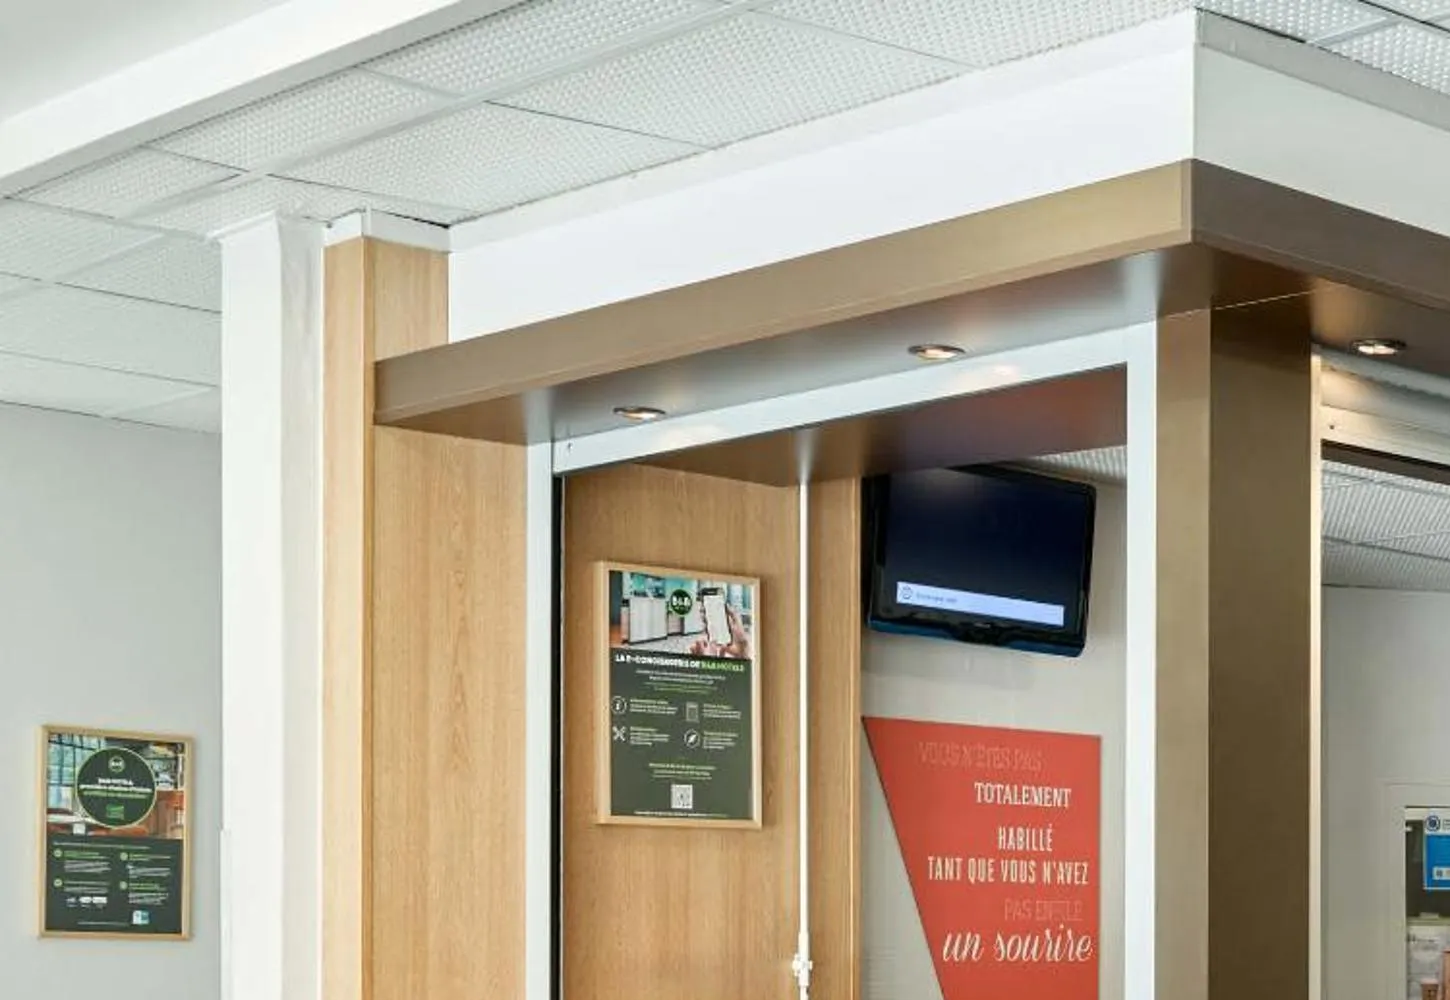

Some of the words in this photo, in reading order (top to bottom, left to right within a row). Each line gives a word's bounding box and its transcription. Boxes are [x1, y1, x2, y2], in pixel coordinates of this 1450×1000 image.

[974, 782, 1072, 808] TOTALEMENT
[998, 823, 1053, 851] HABILLÉ
[928, 856, 963, 880] TANT
[968, 857, 996, 884] QUE
[1001, 859, 1037, 884] VOUS
[1043, 861, 1089, 885] N'AVEZ
[1004, 899, 1032, 921] PAS
[942, 931, 985, 962] un
[994, 924, 1093, 963] sourire
